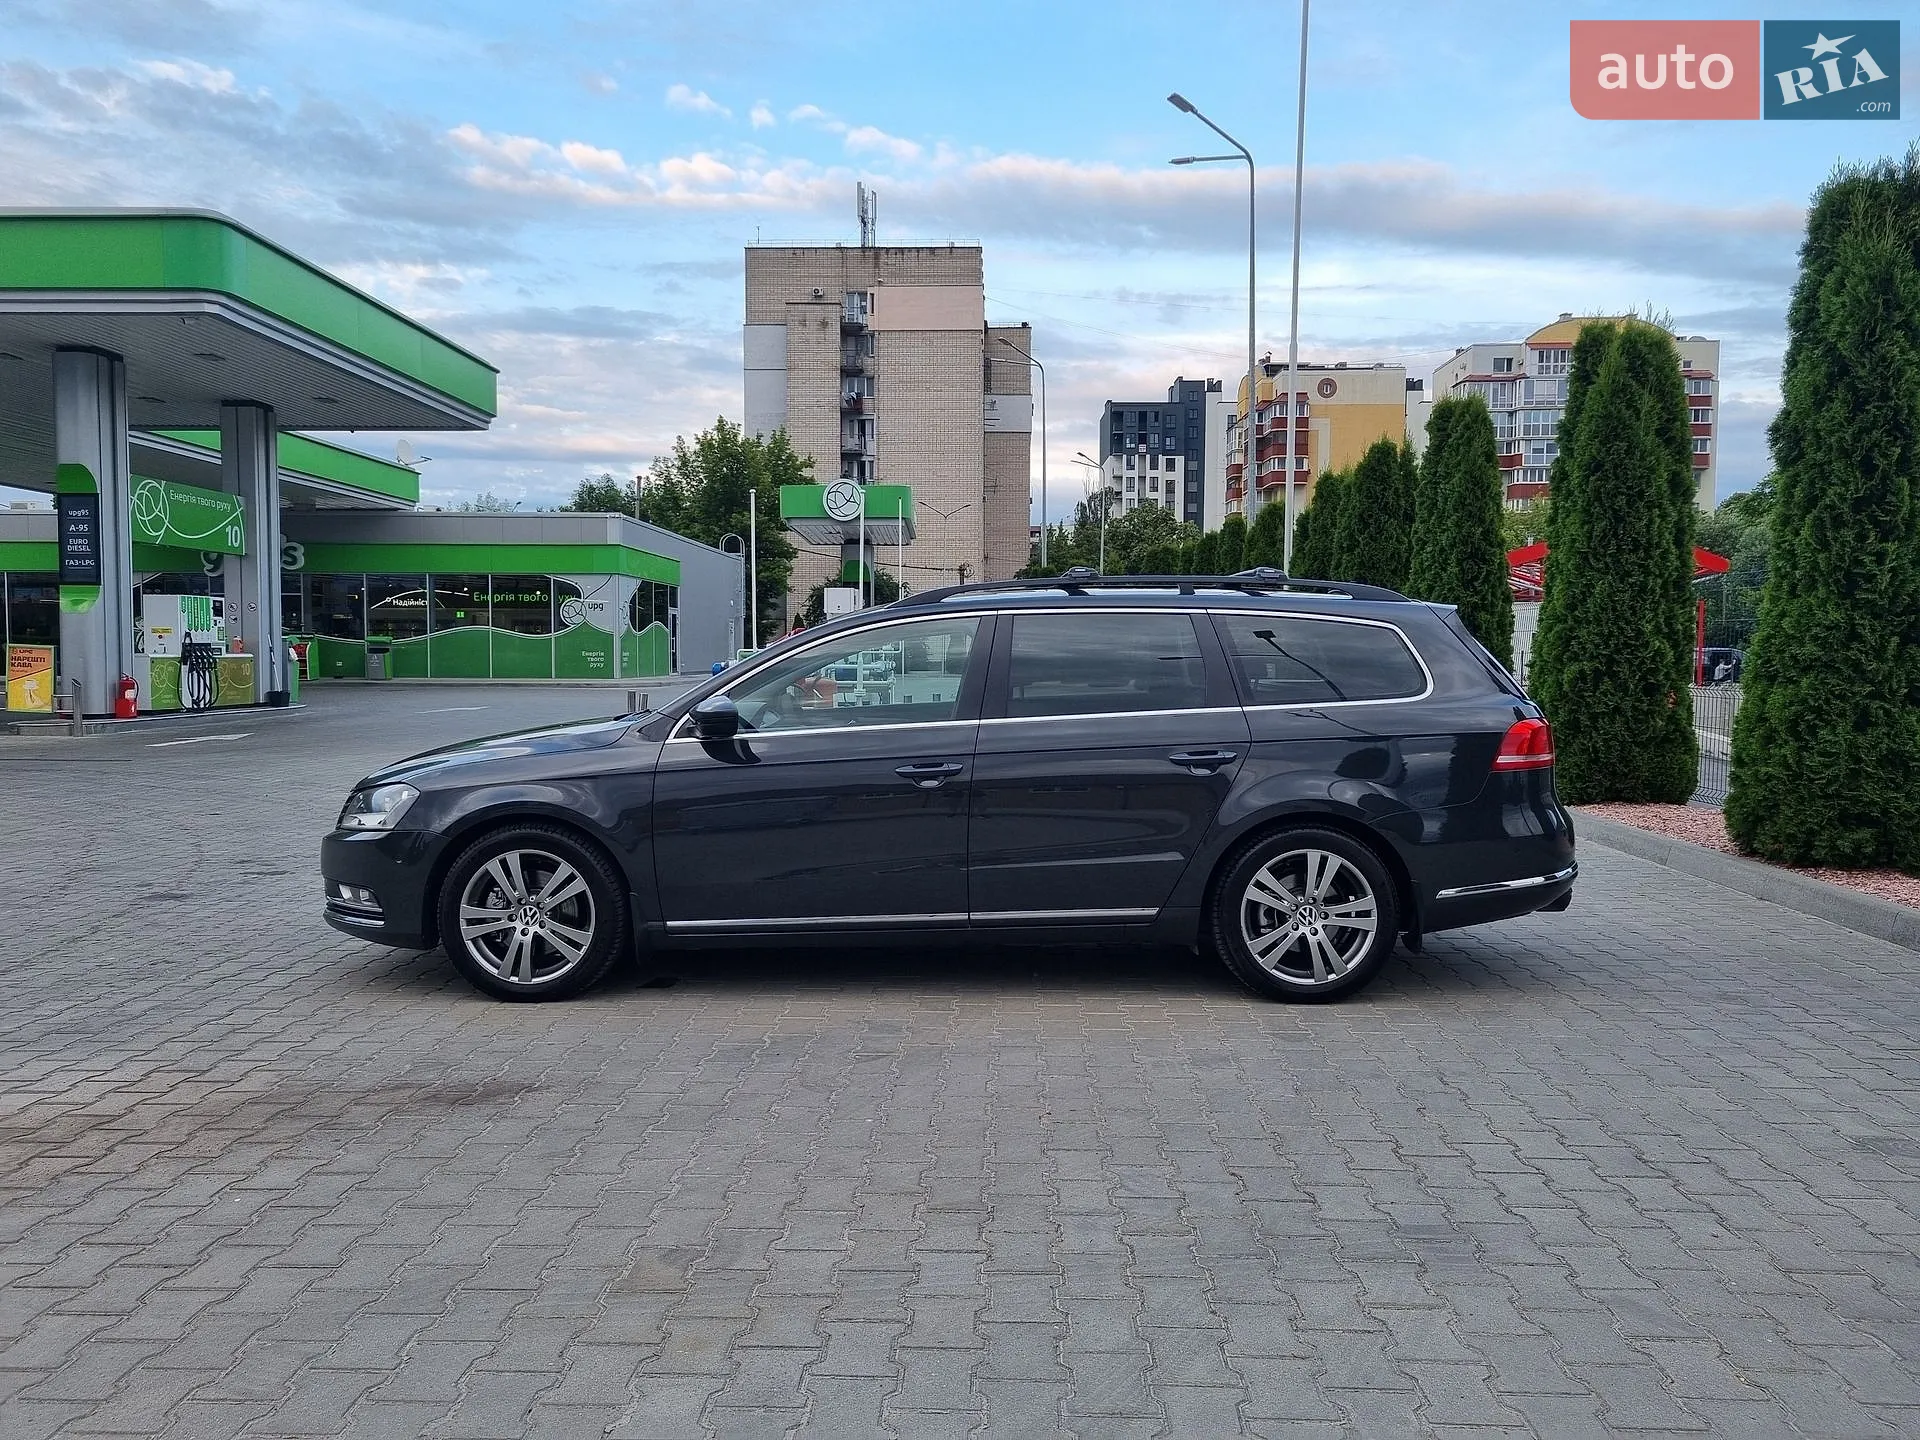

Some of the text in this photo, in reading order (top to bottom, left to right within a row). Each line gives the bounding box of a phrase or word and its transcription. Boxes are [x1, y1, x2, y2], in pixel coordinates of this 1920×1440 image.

[169, 489, 232, 512] Енергія твого руху
[225, 525, 240, 547] 10
[392, 598, 428, 607] Надійніст
[518, 591, 549, 602] твого
[588, 602, 604, 612] upg
[241, 663, 251, 676] 10
